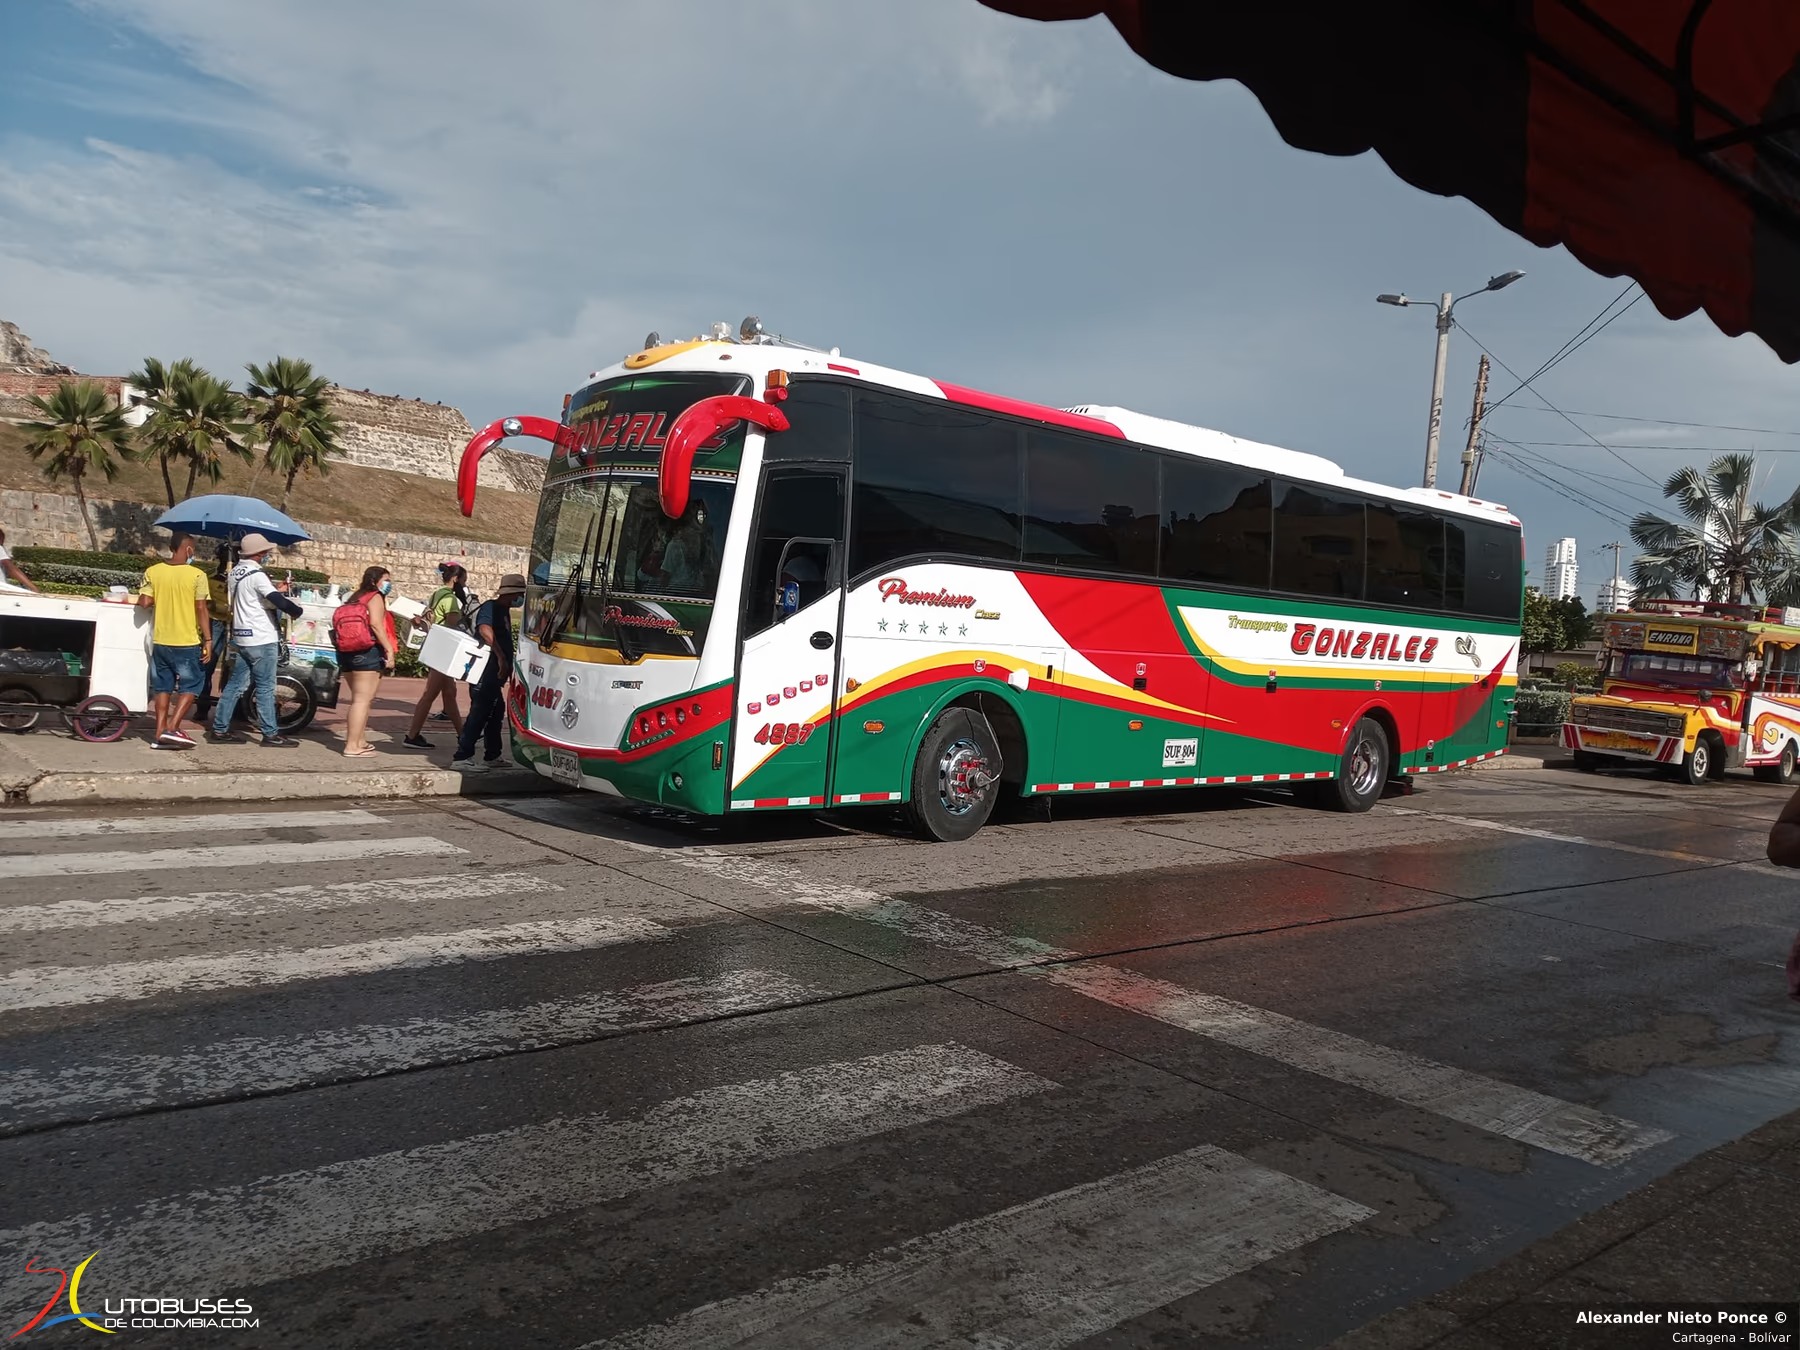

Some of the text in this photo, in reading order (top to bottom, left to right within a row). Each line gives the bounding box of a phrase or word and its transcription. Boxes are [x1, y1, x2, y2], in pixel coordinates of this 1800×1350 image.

[555, 411, 741, 463] GONZALZ
[878, 577, 977, 609] Premium
[1228, 615, 1288, 633] Transportes
[1290, 623, 1439, 662] GONZALEZ
[754, 723, 815, 745] 4887
[1165, 744, 1196, 758] SUF 804
